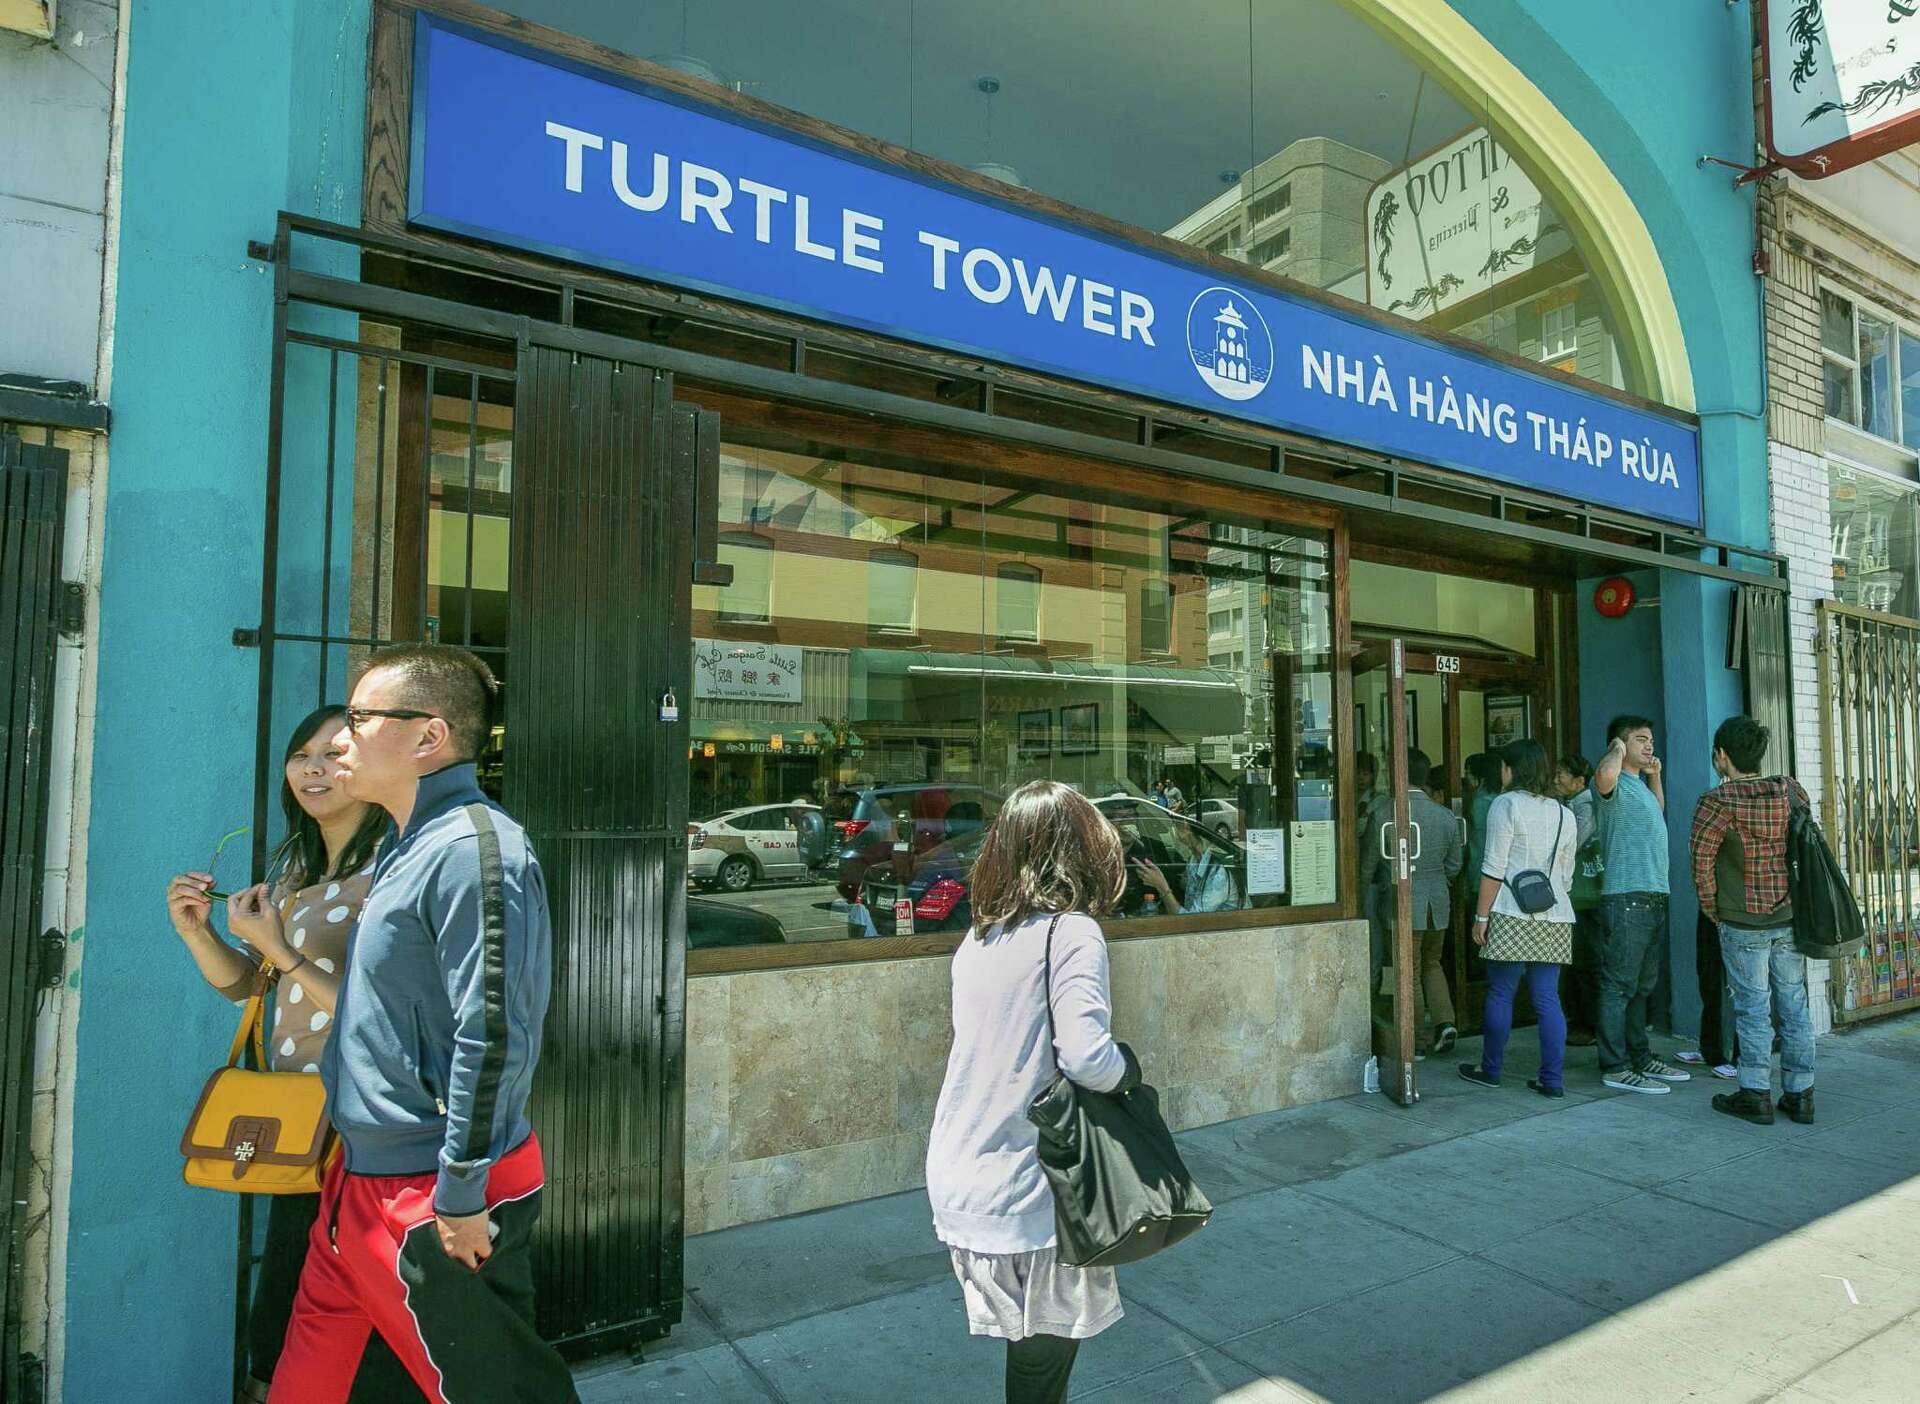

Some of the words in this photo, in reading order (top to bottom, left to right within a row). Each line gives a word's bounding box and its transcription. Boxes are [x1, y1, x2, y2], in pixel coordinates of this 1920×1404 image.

[546, 121, 884, 274] TURTLE
[918, 230, 1156, 346] TOWER
[1302, 344, 1398, 412] NHÀ
[1408, 375, 1519, 444] HÀNG
[1526, 411, 1613, 468] THÁP
[1621, 437, 1680, 488] RÙA
[1438, 656, 1458, 671] 645
